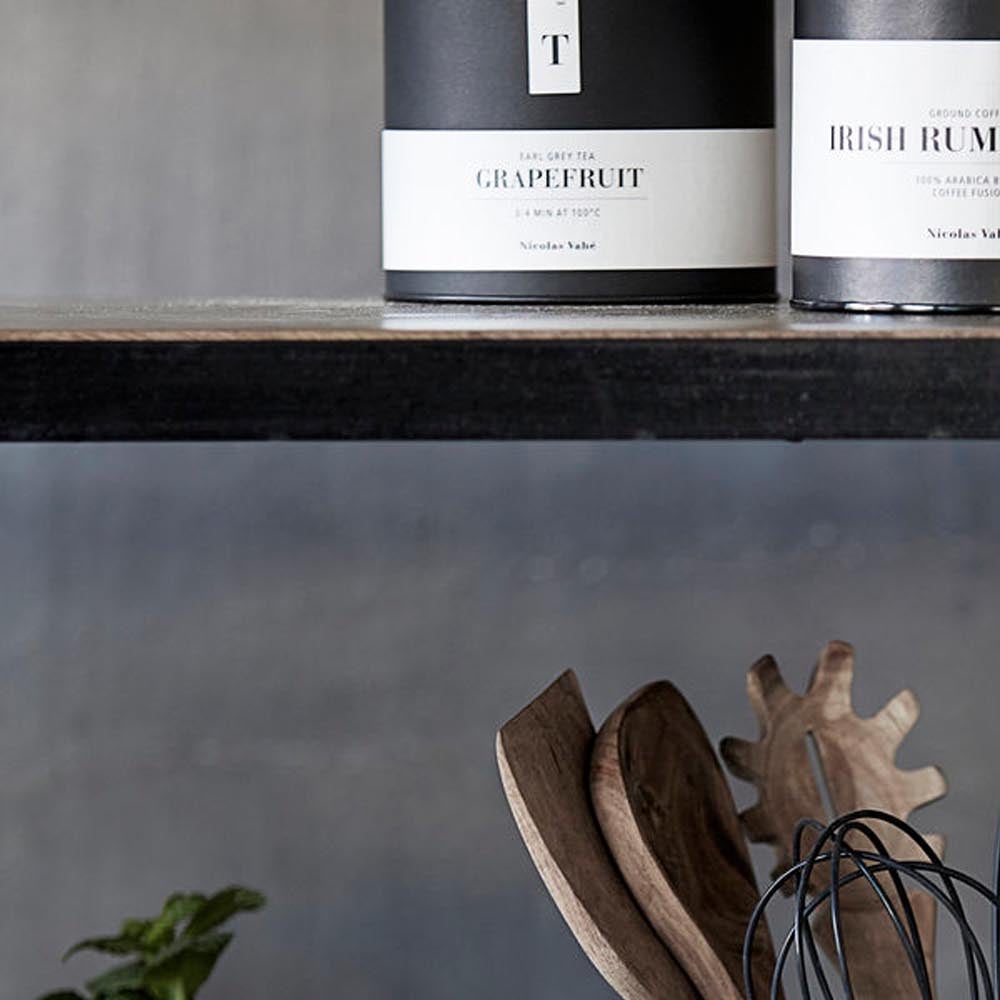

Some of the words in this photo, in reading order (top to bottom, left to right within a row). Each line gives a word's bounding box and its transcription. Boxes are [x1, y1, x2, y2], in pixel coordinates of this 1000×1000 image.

[541, 34, 569, 65] T
[929, 109, 972, 118] GROUND
[830, 125, 905, 151] IRISH
[921, 126, 996, 152] RUM
[547, 151, 573, 161] GREY
[577, 151, 595, 161] TEA
[476, 167, 644, 189] GRAPEFRUIT
[945, 175, 990, 185] ARABICA
[932, 188, 967, 198] COFFEE
[927, 227, 977, 239] Nicolas
[519, 241, 564, 250] Nicolas
